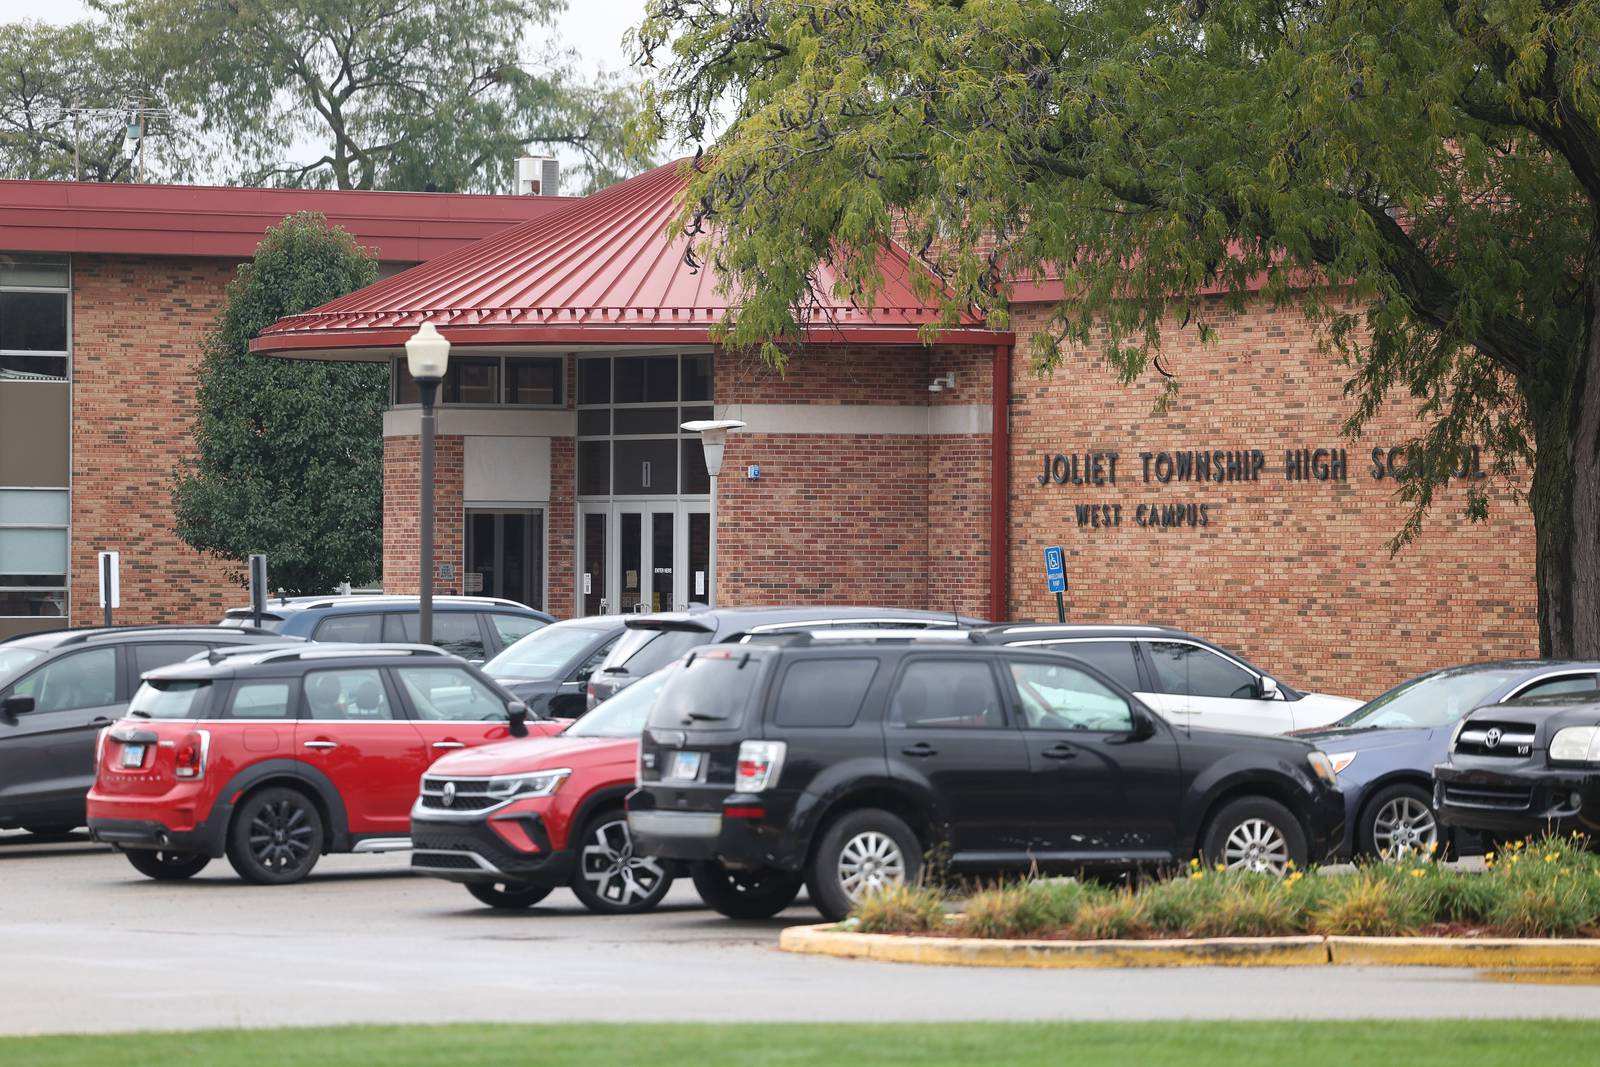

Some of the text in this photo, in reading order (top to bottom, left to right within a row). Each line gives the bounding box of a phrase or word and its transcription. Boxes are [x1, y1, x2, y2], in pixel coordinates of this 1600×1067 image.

[1037, 452, 1119, 485] JOLIET
[1138, 449, 1265, 483] TOWNSHIP
[1285, 448, 1347, 481] HIGH
[1075, 503, 1209, 528] WEST CAMPUS
